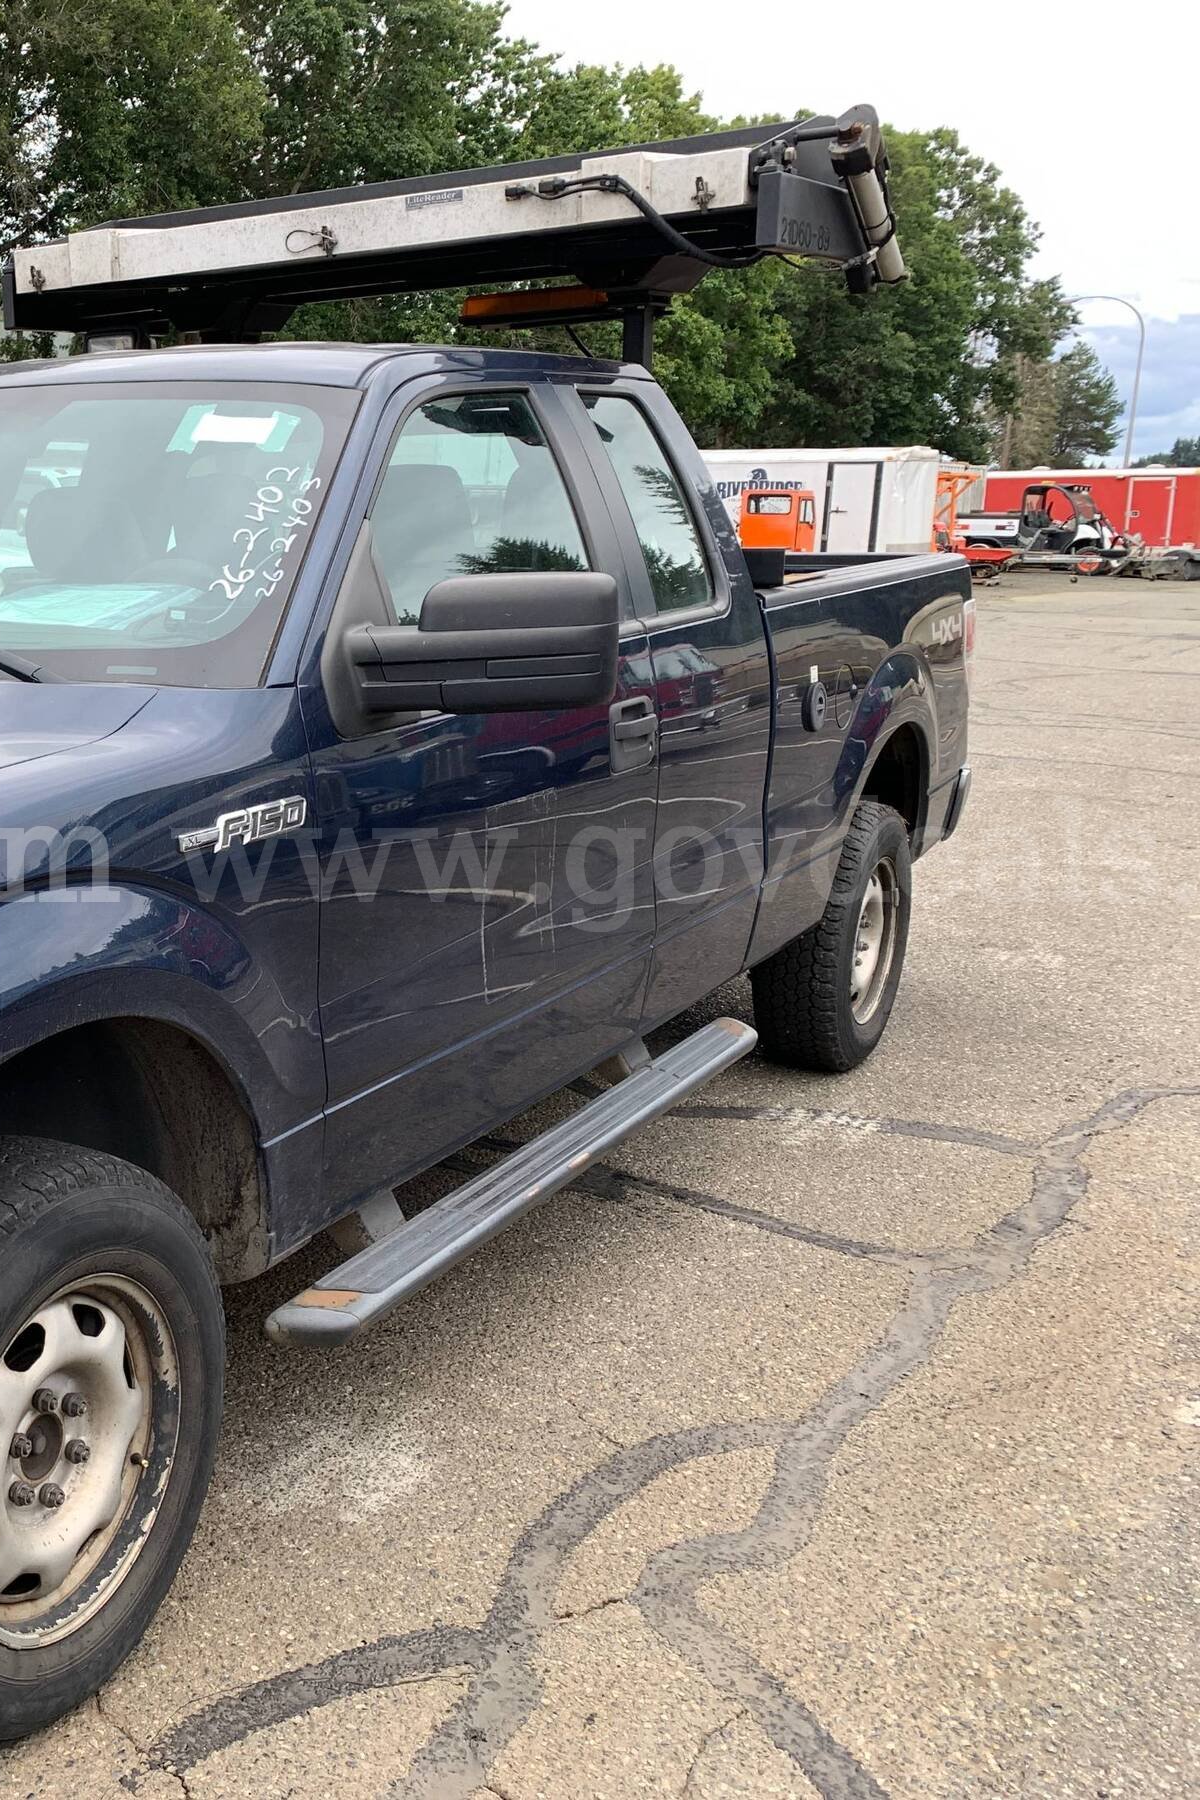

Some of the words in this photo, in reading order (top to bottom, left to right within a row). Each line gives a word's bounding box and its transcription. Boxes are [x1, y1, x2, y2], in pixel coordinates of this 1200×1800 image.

[407, 191, 457, 204] LiteReader
[209, 467, 300, 599] 26-2402
[255, 477, 321, 597] 26-2403
[187, 834, 202, 846] XL
